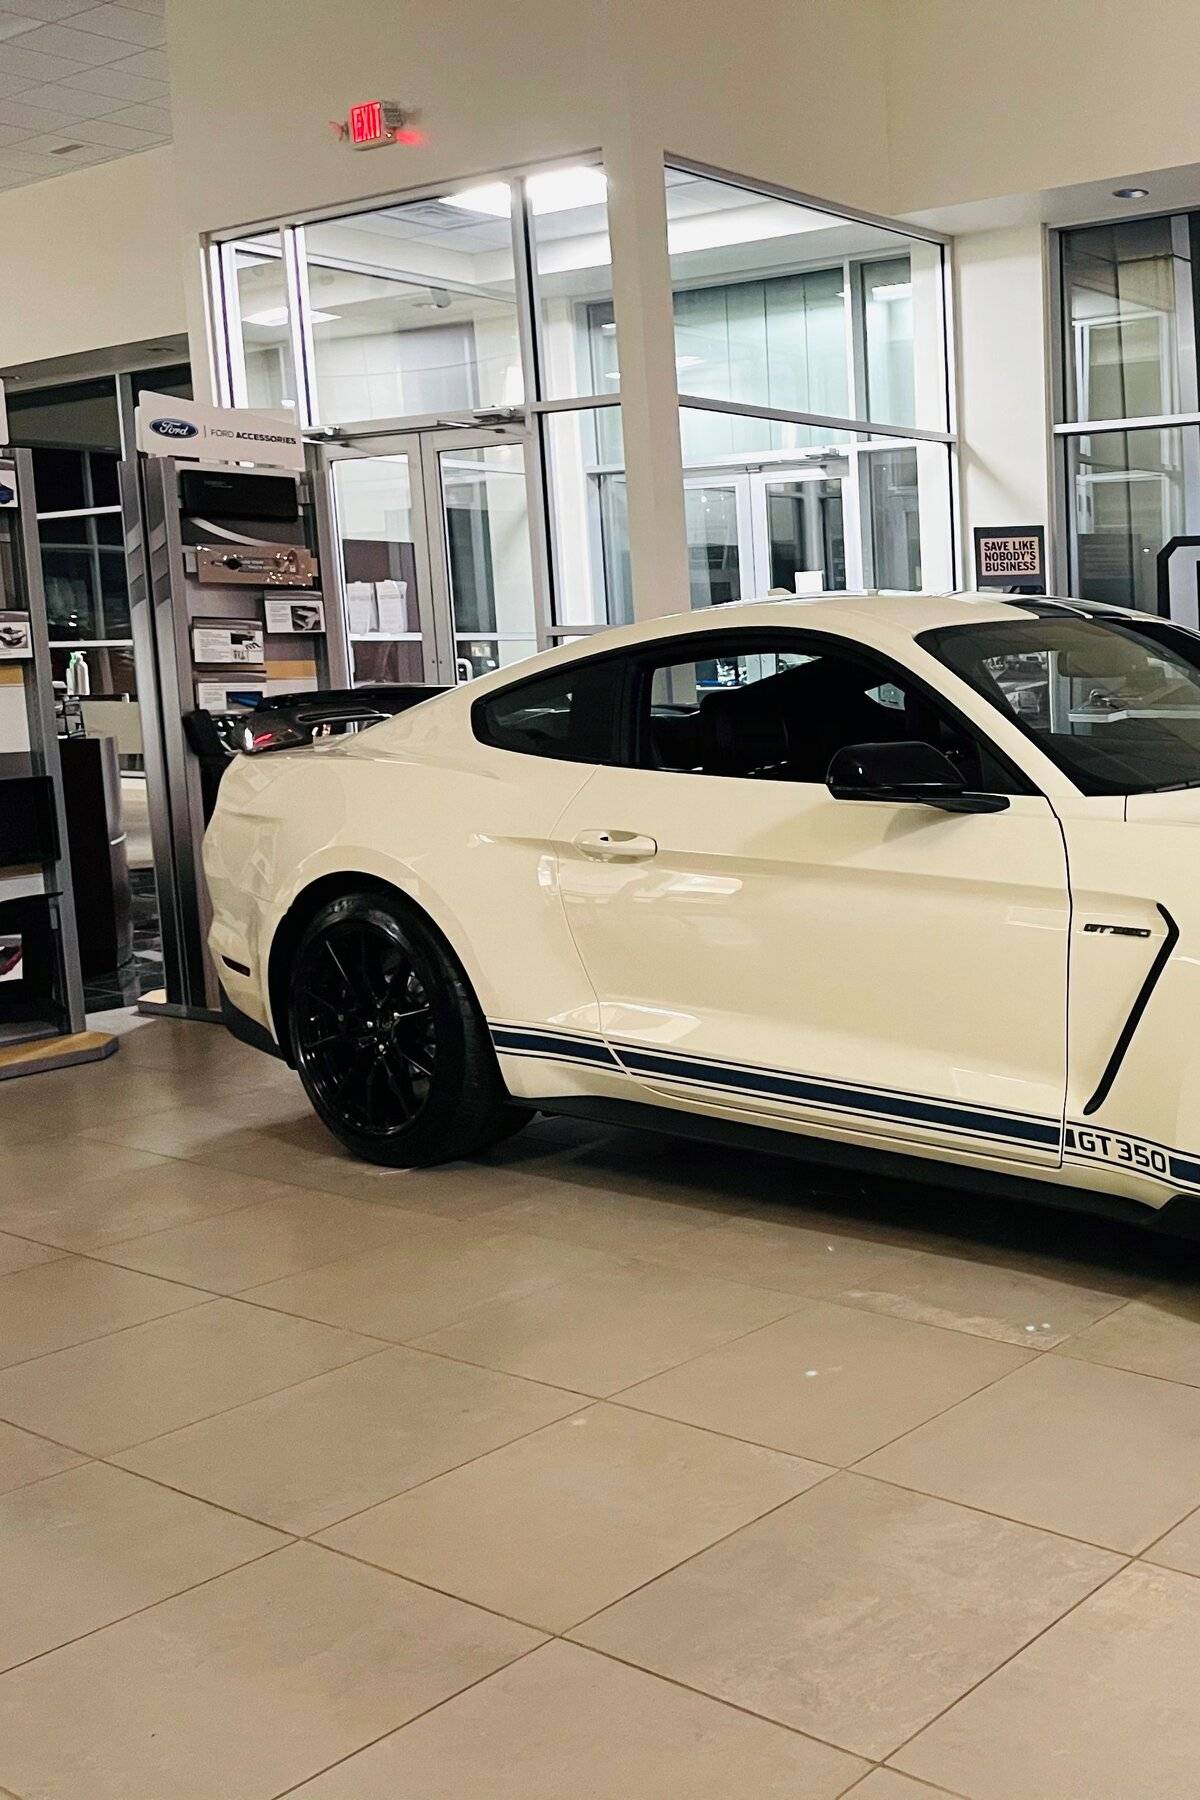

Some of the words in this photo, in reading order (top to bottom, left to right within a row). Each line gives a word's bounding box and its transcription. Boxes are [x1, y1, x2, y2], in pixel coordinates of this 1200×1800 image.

[353, 103, 380, 142] EXIT
[159, 420, 189, 436] Ford
[210, 428, 235, 439] FORD
[236, 431, 297, 445] ACCESSORIES
[984, 541, 1010, 551] SAVE
[1012, 540, 1036, 550] LIKE
[985, 551, 1037, 561] NOBODY'S
[985, 561, 1036, 572] BUSINESS
[1078, 1131, 1112, 1156] GT
[1115, 1138, 1167, 1173] 350
